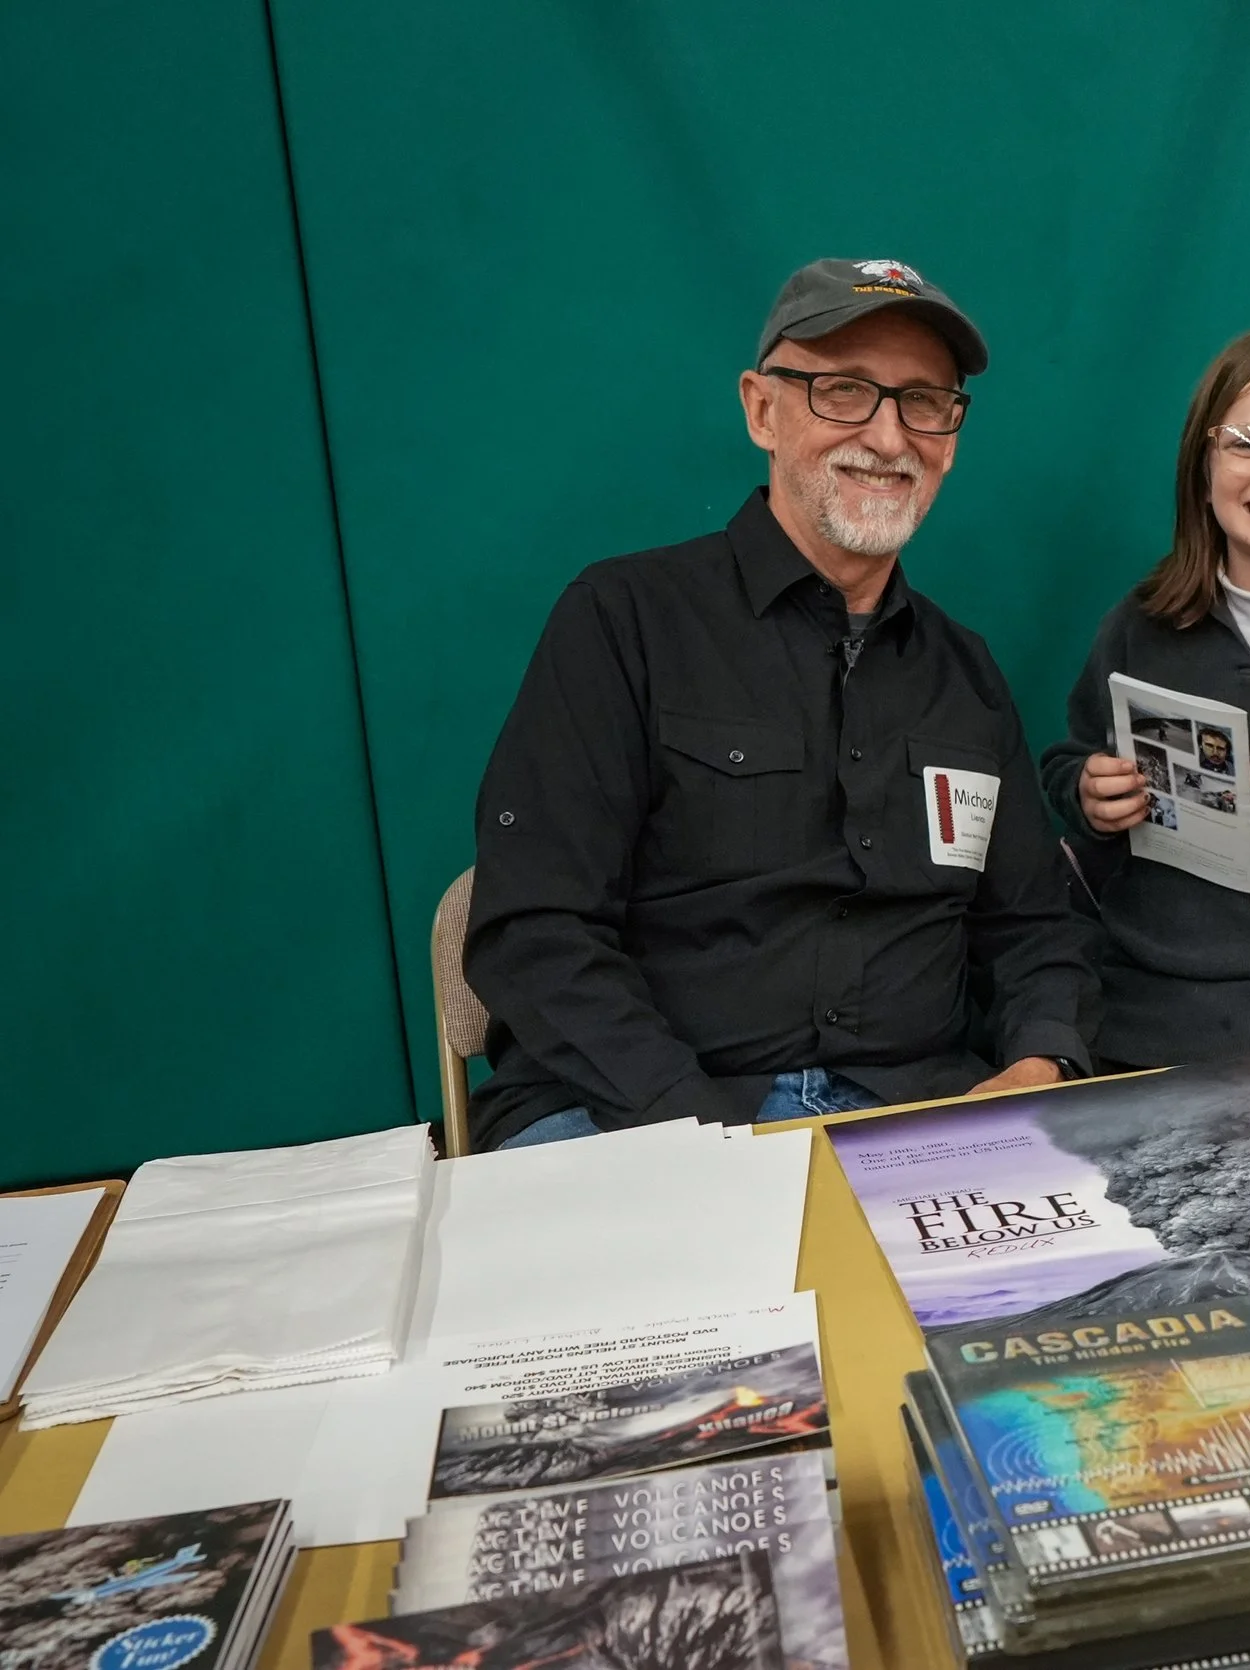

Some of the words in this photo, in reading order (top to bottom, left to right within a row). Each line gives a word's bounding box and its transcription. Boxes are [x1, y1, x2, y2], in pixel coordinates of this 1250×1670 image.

[954, 788, 995, 811] Michael
[860, 1157, 886, 1165] One
[958, 1134, 1032, 1151] unforgettable
[973, 1146, 993, 1154] US
[995, 1140, 1034, 1152] history
[899, 1191, 989, 1216] THE
[906, 1192, 1087, 1241] FIRE
[921, 1223, 1038, 1251] BELOW
[1052, 1214, 1096, 1231] US
[692, 1327, 719, 1335] DVD
[960, 1308, 1247, 1364] CASCADIA
[620, 1331, 690, 1345] POSTCARD
[640, 1337, 687, 1348] MOUNT
[548, 1344, 581, 1355] WITH
[567, 1346, 617, 1357] HELENS
[584, 1340, 617, 1350] FREE
[621, 1343, 637, 1351] ST
[1032, 1354, 1070, 1367] The
[1074, 1342, 1147, 1361] Hidden
[1150, 1335, 1192, 1351] Fire
[442, 1352, 515, 1367] PURCHASE
[511, 1352, 563, 1365] POSTER
[518, 1348, 546, 1358] ANY
[652, 1352, 682, 1361] FIRE
[474, 1361, 508, 1370] FREE
[576, 1363, 598, 1372] US
[602, 1357, 649, 1369] BELOW
[573, 1369, 598, 1377] KIT
[490, 1373, 572, 1389] DVD/CDROM
[540, 1380, 567, 1389] DVD
[568, 1376, 592, 1385] KIT
[528, 1378, 631, 1397] DOCUMENTARY
[470, 1539, 586, 1577] ACTIVE
[611, 1505, 788, 1553] VOLCANOES
[119, 1630, 200, 1653] Sticker
